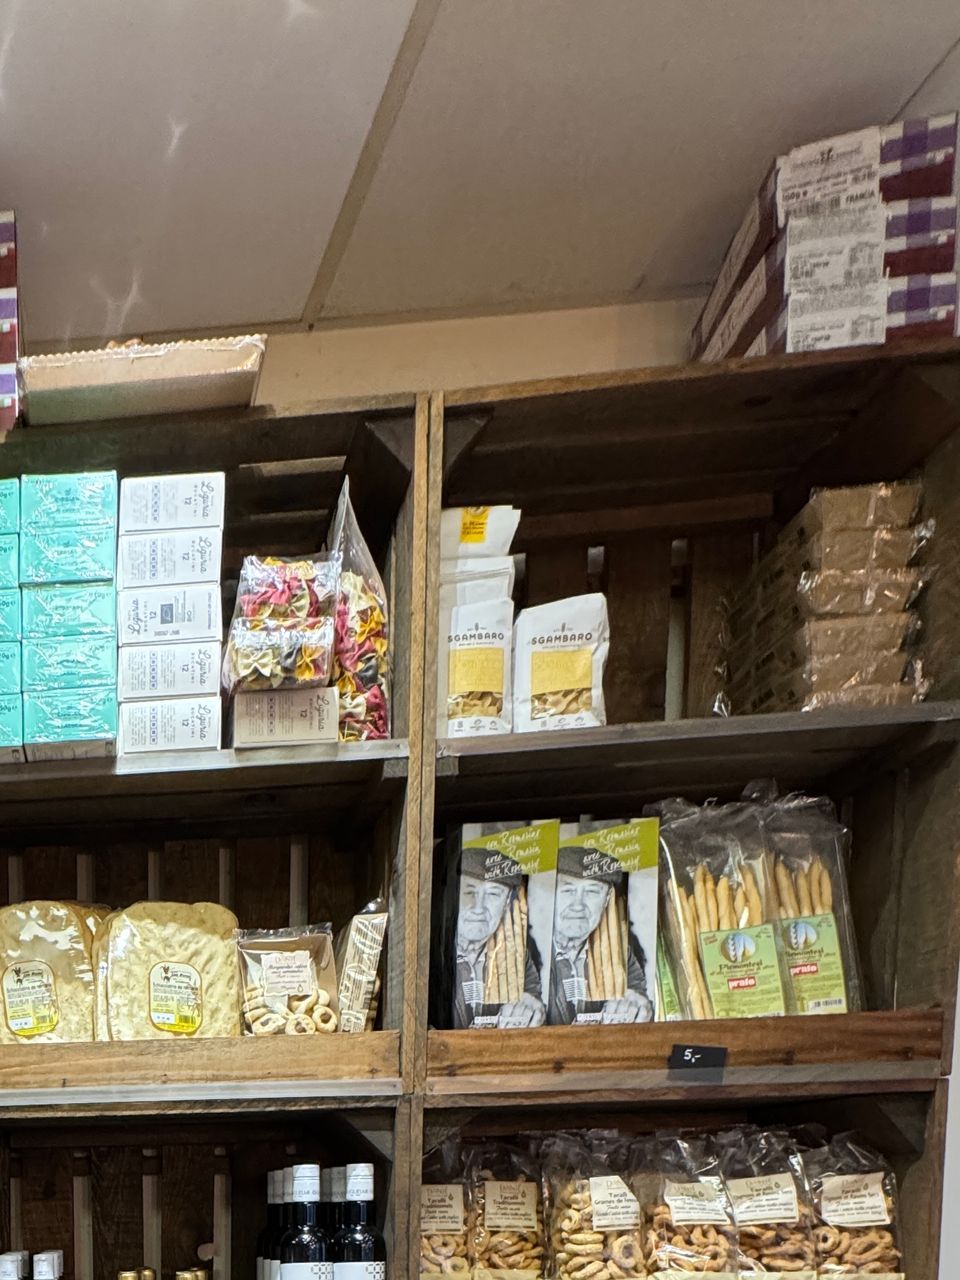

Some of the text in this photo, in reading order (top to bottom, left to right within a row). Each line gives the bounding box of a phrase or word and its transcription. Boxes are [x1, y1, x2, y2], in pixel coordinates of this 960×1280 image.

[448, 632, 505, 643] SGAMBARO
[532, 632, 593, 645] SGAMBARO
[198, 648, 212, 688] Liguria
[198, 703, 212, 741] Liguria
